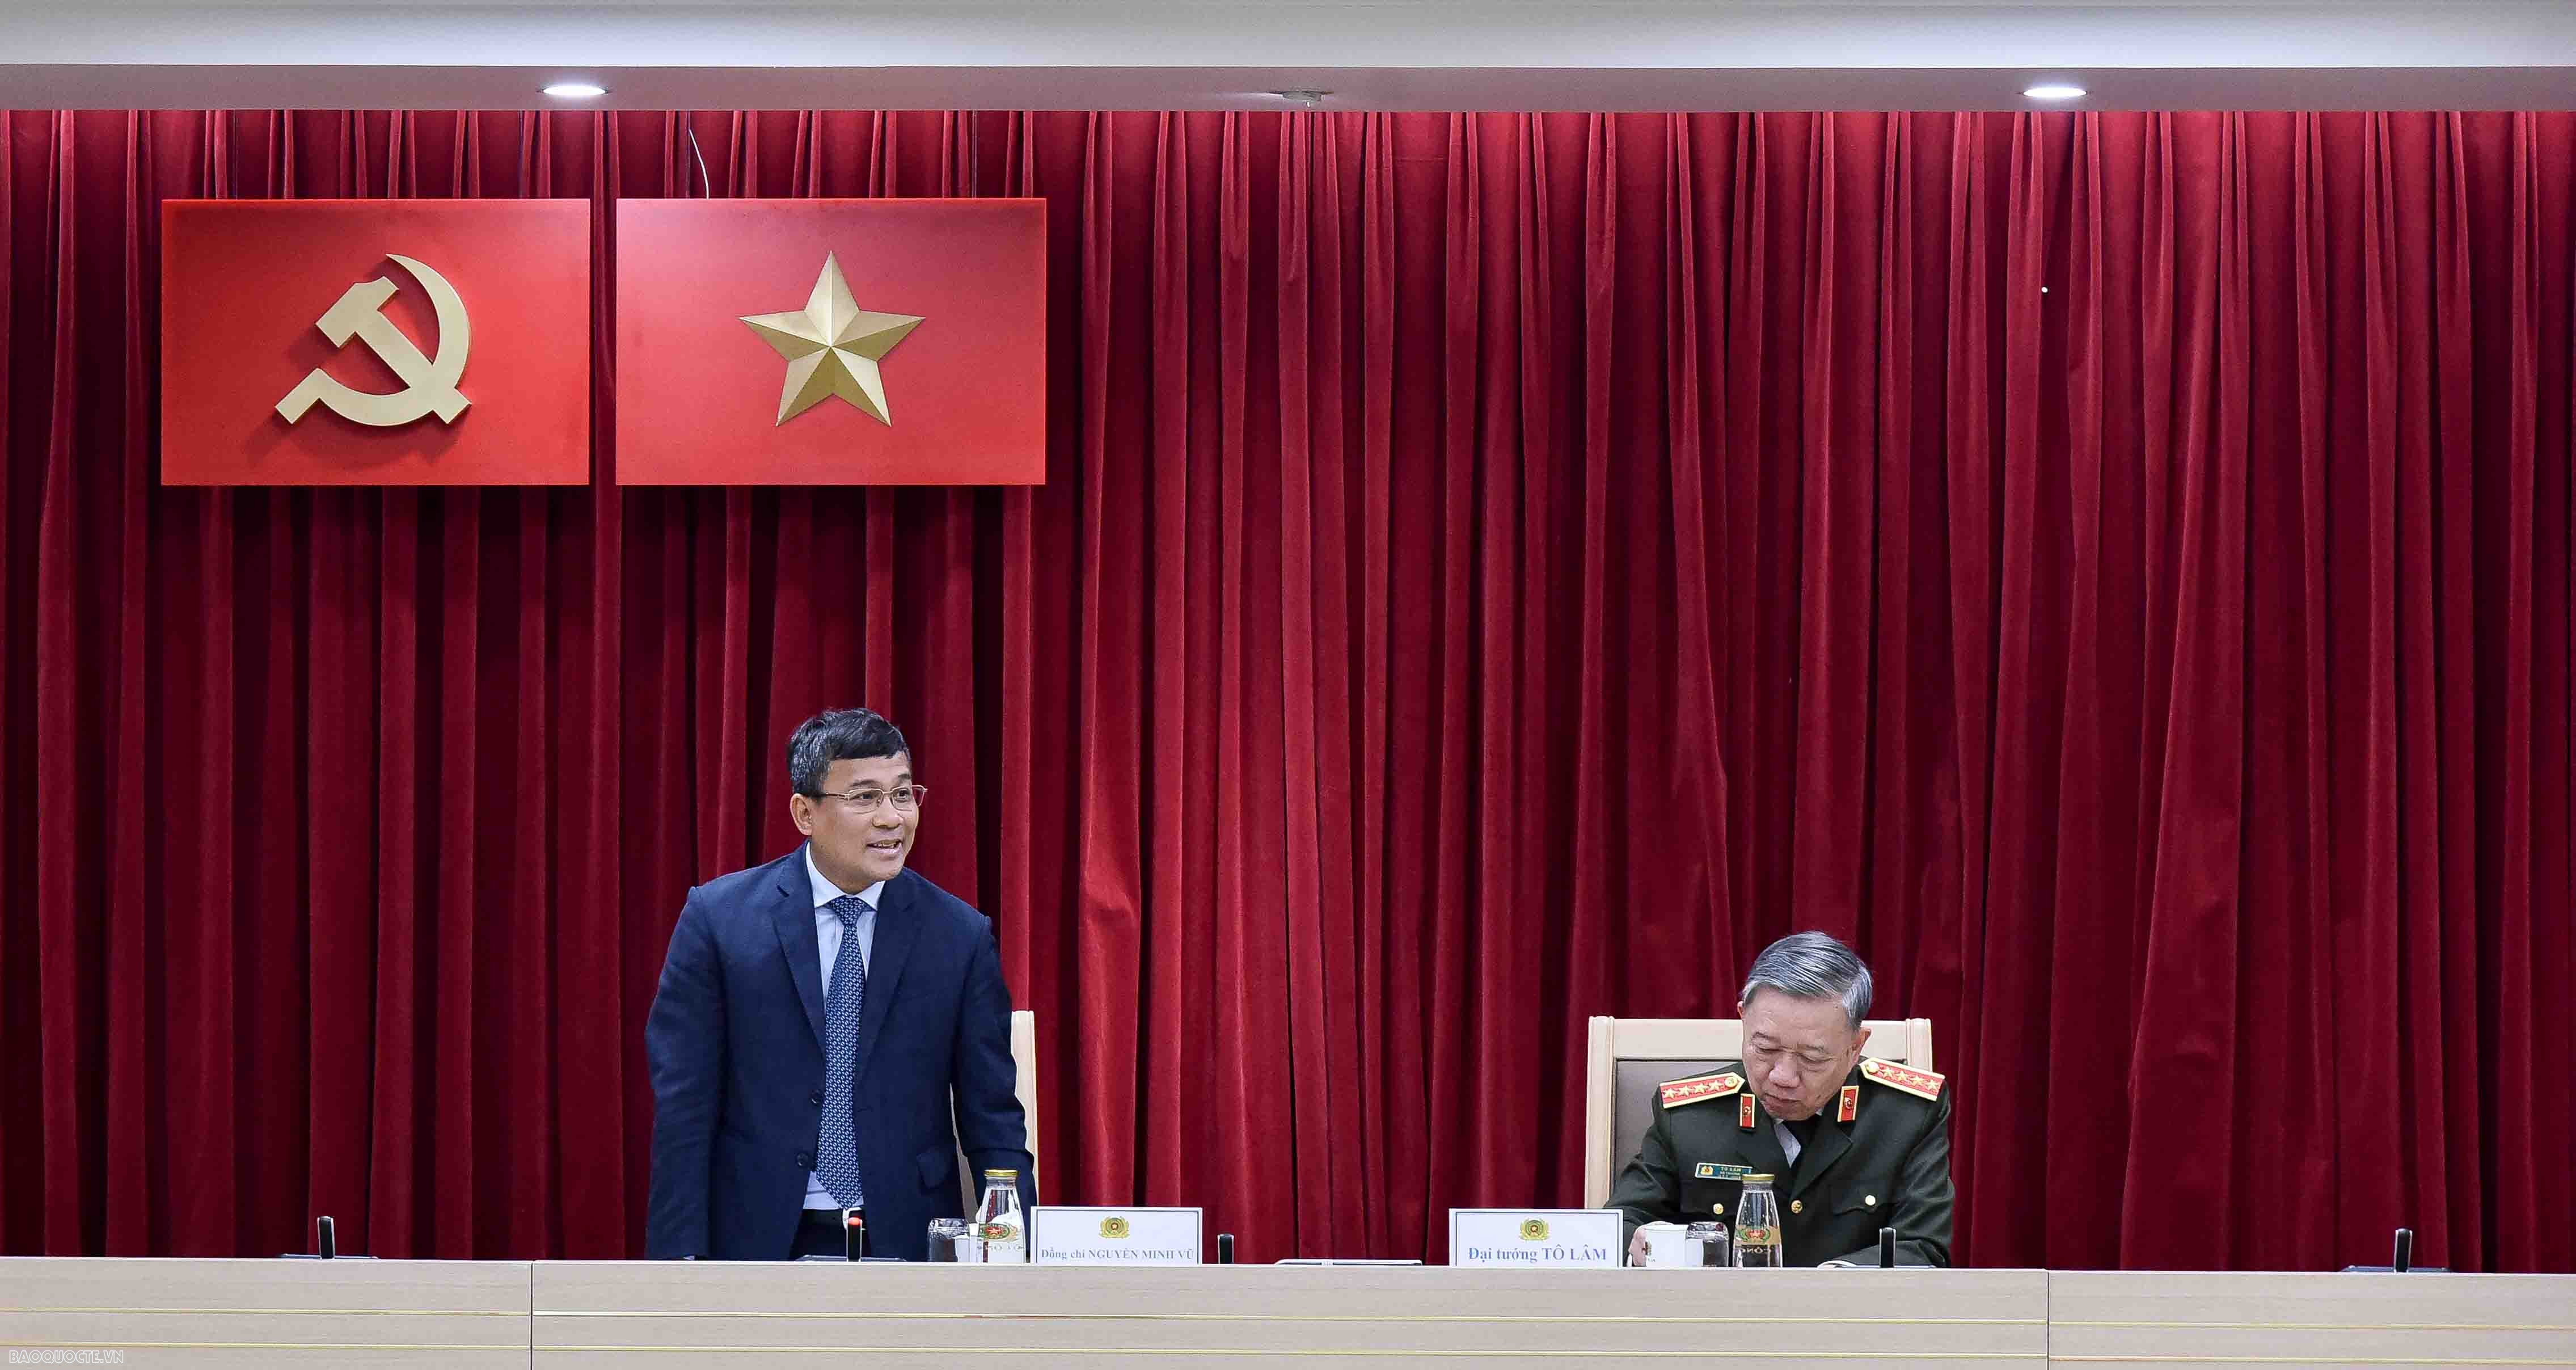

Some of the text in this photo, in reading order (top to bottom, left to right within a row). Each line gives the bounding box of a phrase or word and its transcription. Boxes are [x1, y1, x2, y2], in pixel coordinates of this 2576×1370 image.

[1142, 1250, 1173, 1259] MINH
[1178, 1248, 1193, 1259] VŨ
[1469, 1244, 1606, 1263] Đại tướng TÔ LÂM
